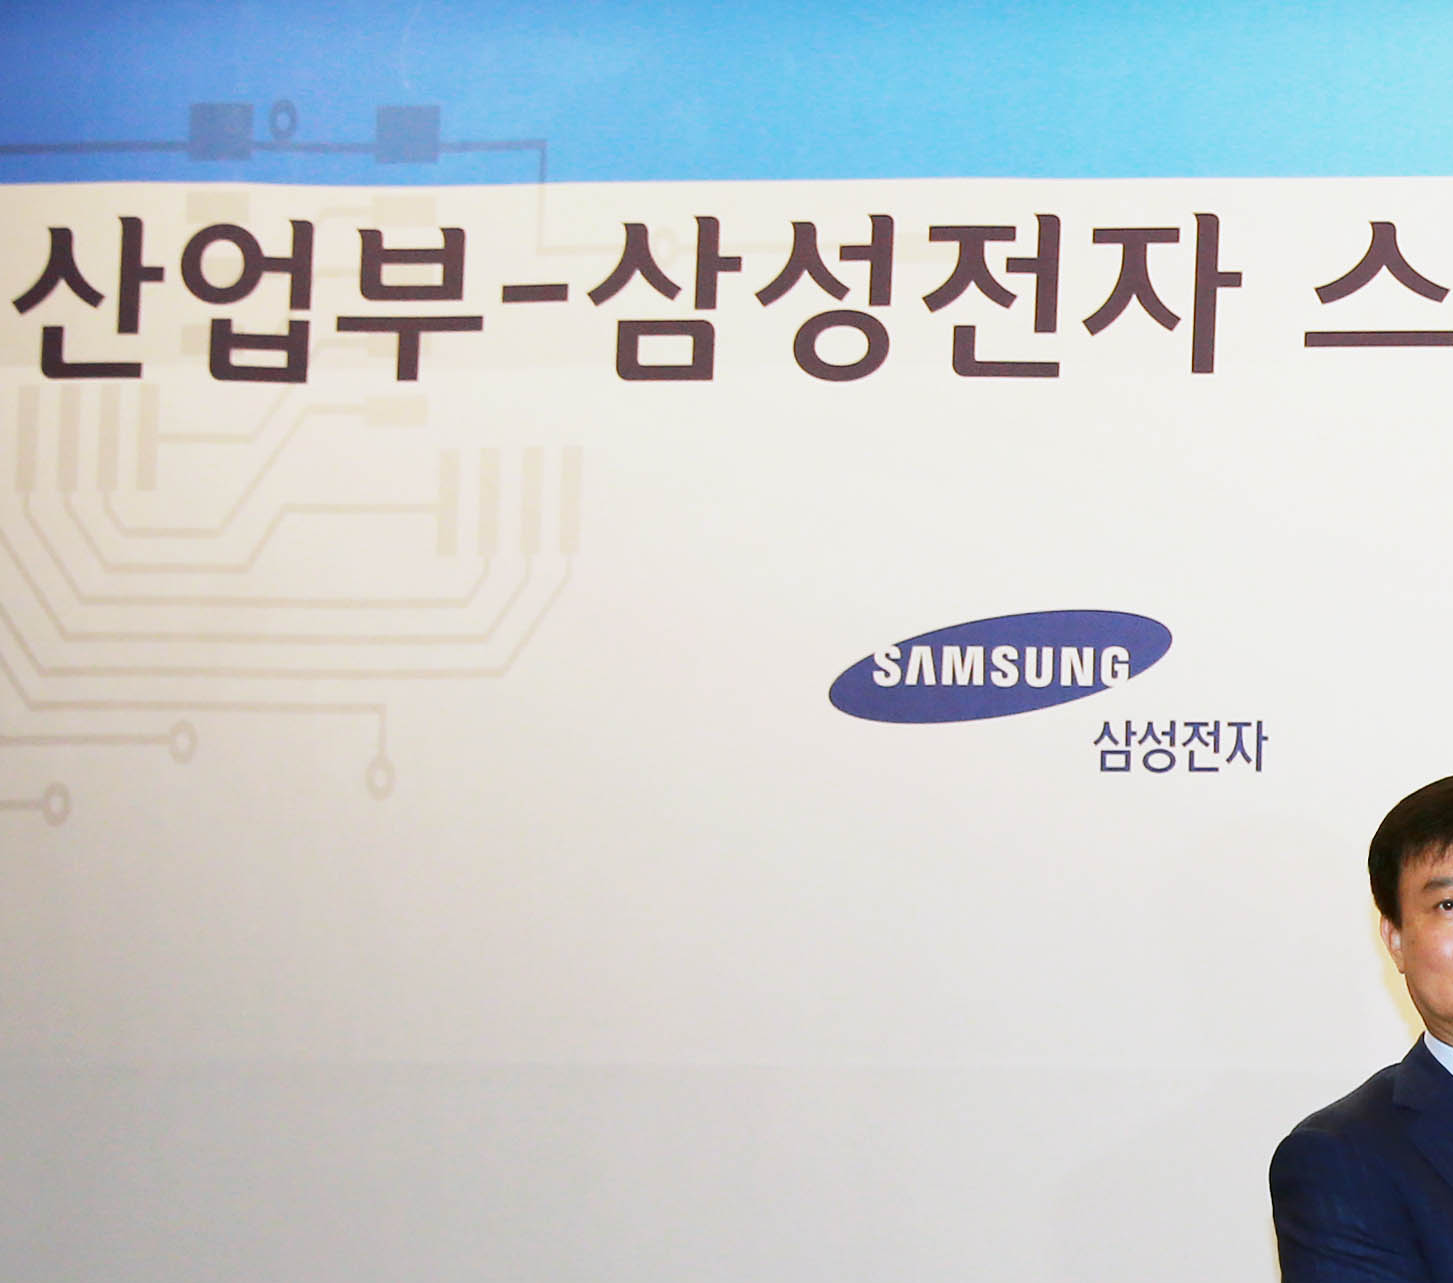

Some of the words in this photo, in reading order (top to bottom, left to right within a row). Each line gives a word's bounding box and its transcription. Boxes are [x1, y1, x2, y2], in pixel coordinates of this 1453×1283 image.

[13, 214, 1242, 383] 산업부-삼성전자
[872, 644, 1131, 688] SAMSUNG
[1093, 720, 1269, 773] 삼성전자
